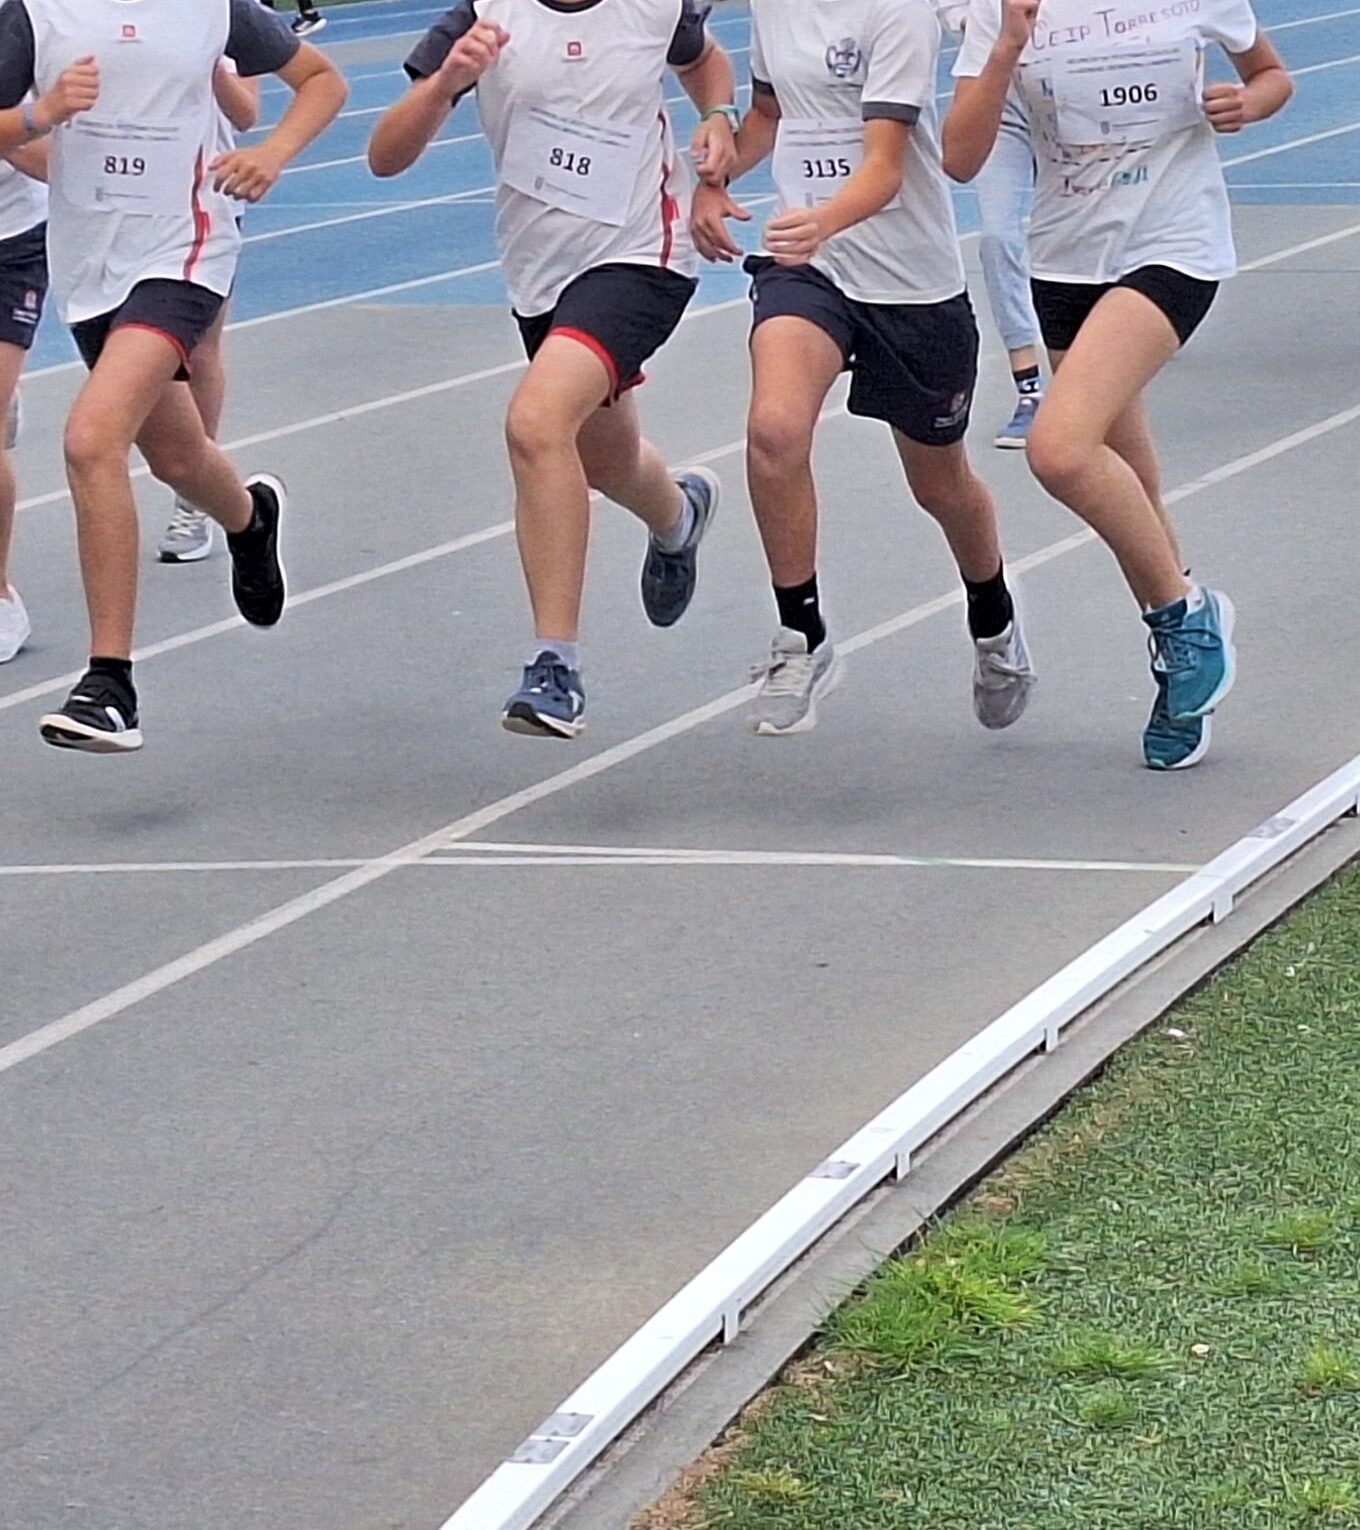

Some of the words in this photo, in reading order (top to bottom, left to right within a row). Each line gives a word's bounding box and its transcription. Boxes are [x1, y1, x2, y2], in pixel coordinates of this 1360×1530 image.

[1099, 83, 1158, 107] 1906
[104, 156, 146, 177] 819
[549, 147, 592, 176] 818
[802, 158, 852, 179] 3135
